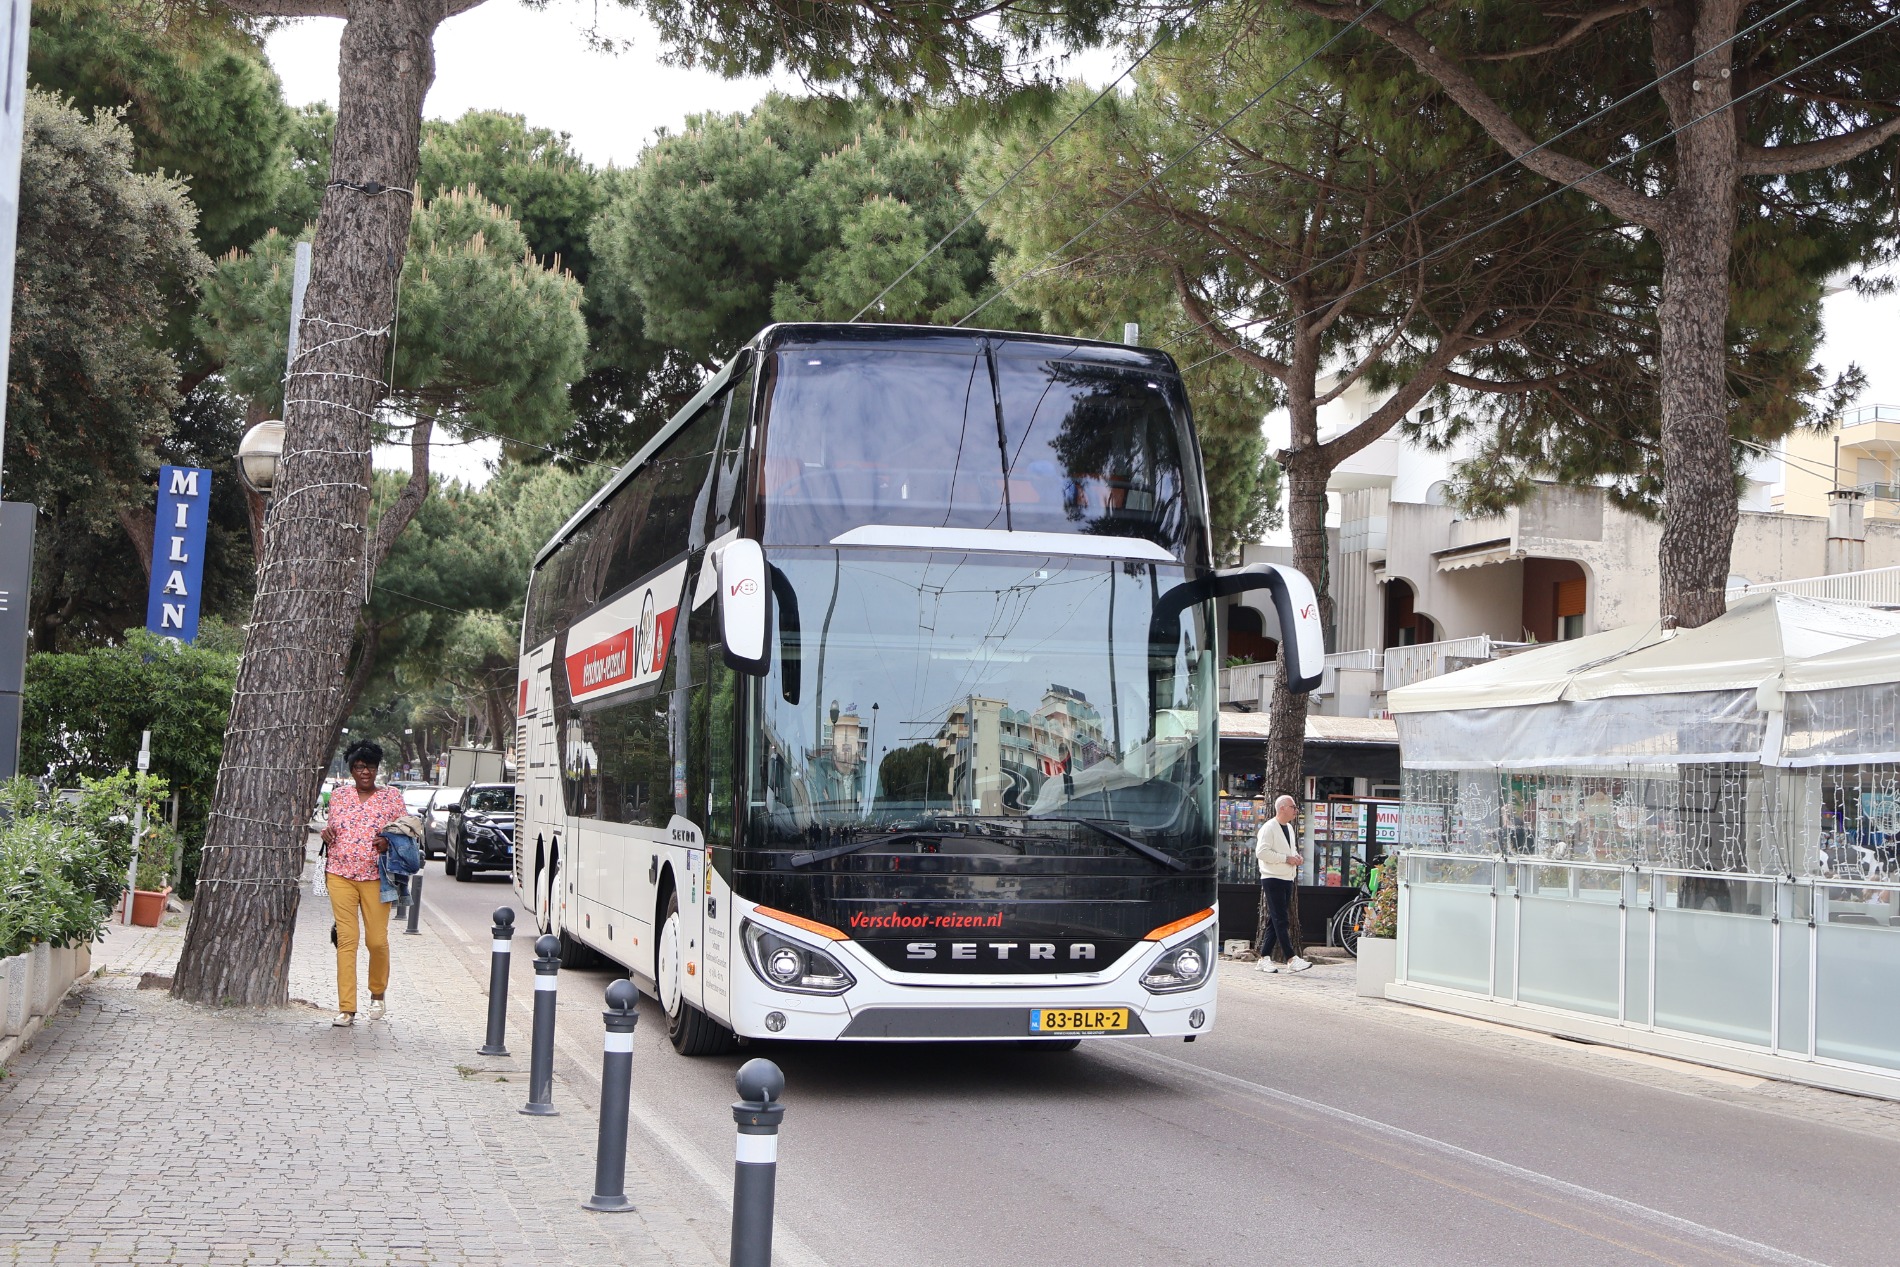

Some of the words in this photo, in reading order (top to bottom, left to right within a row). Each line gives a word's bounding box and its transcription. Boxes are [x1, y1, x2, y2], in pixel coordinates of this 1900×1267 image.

[850, 911, 1003, 928] Verschoor-reizen.nl
[906, 942, 1096, 960] SETRA
[1046, 1012, 1121, 1028] 83-BLR-2
